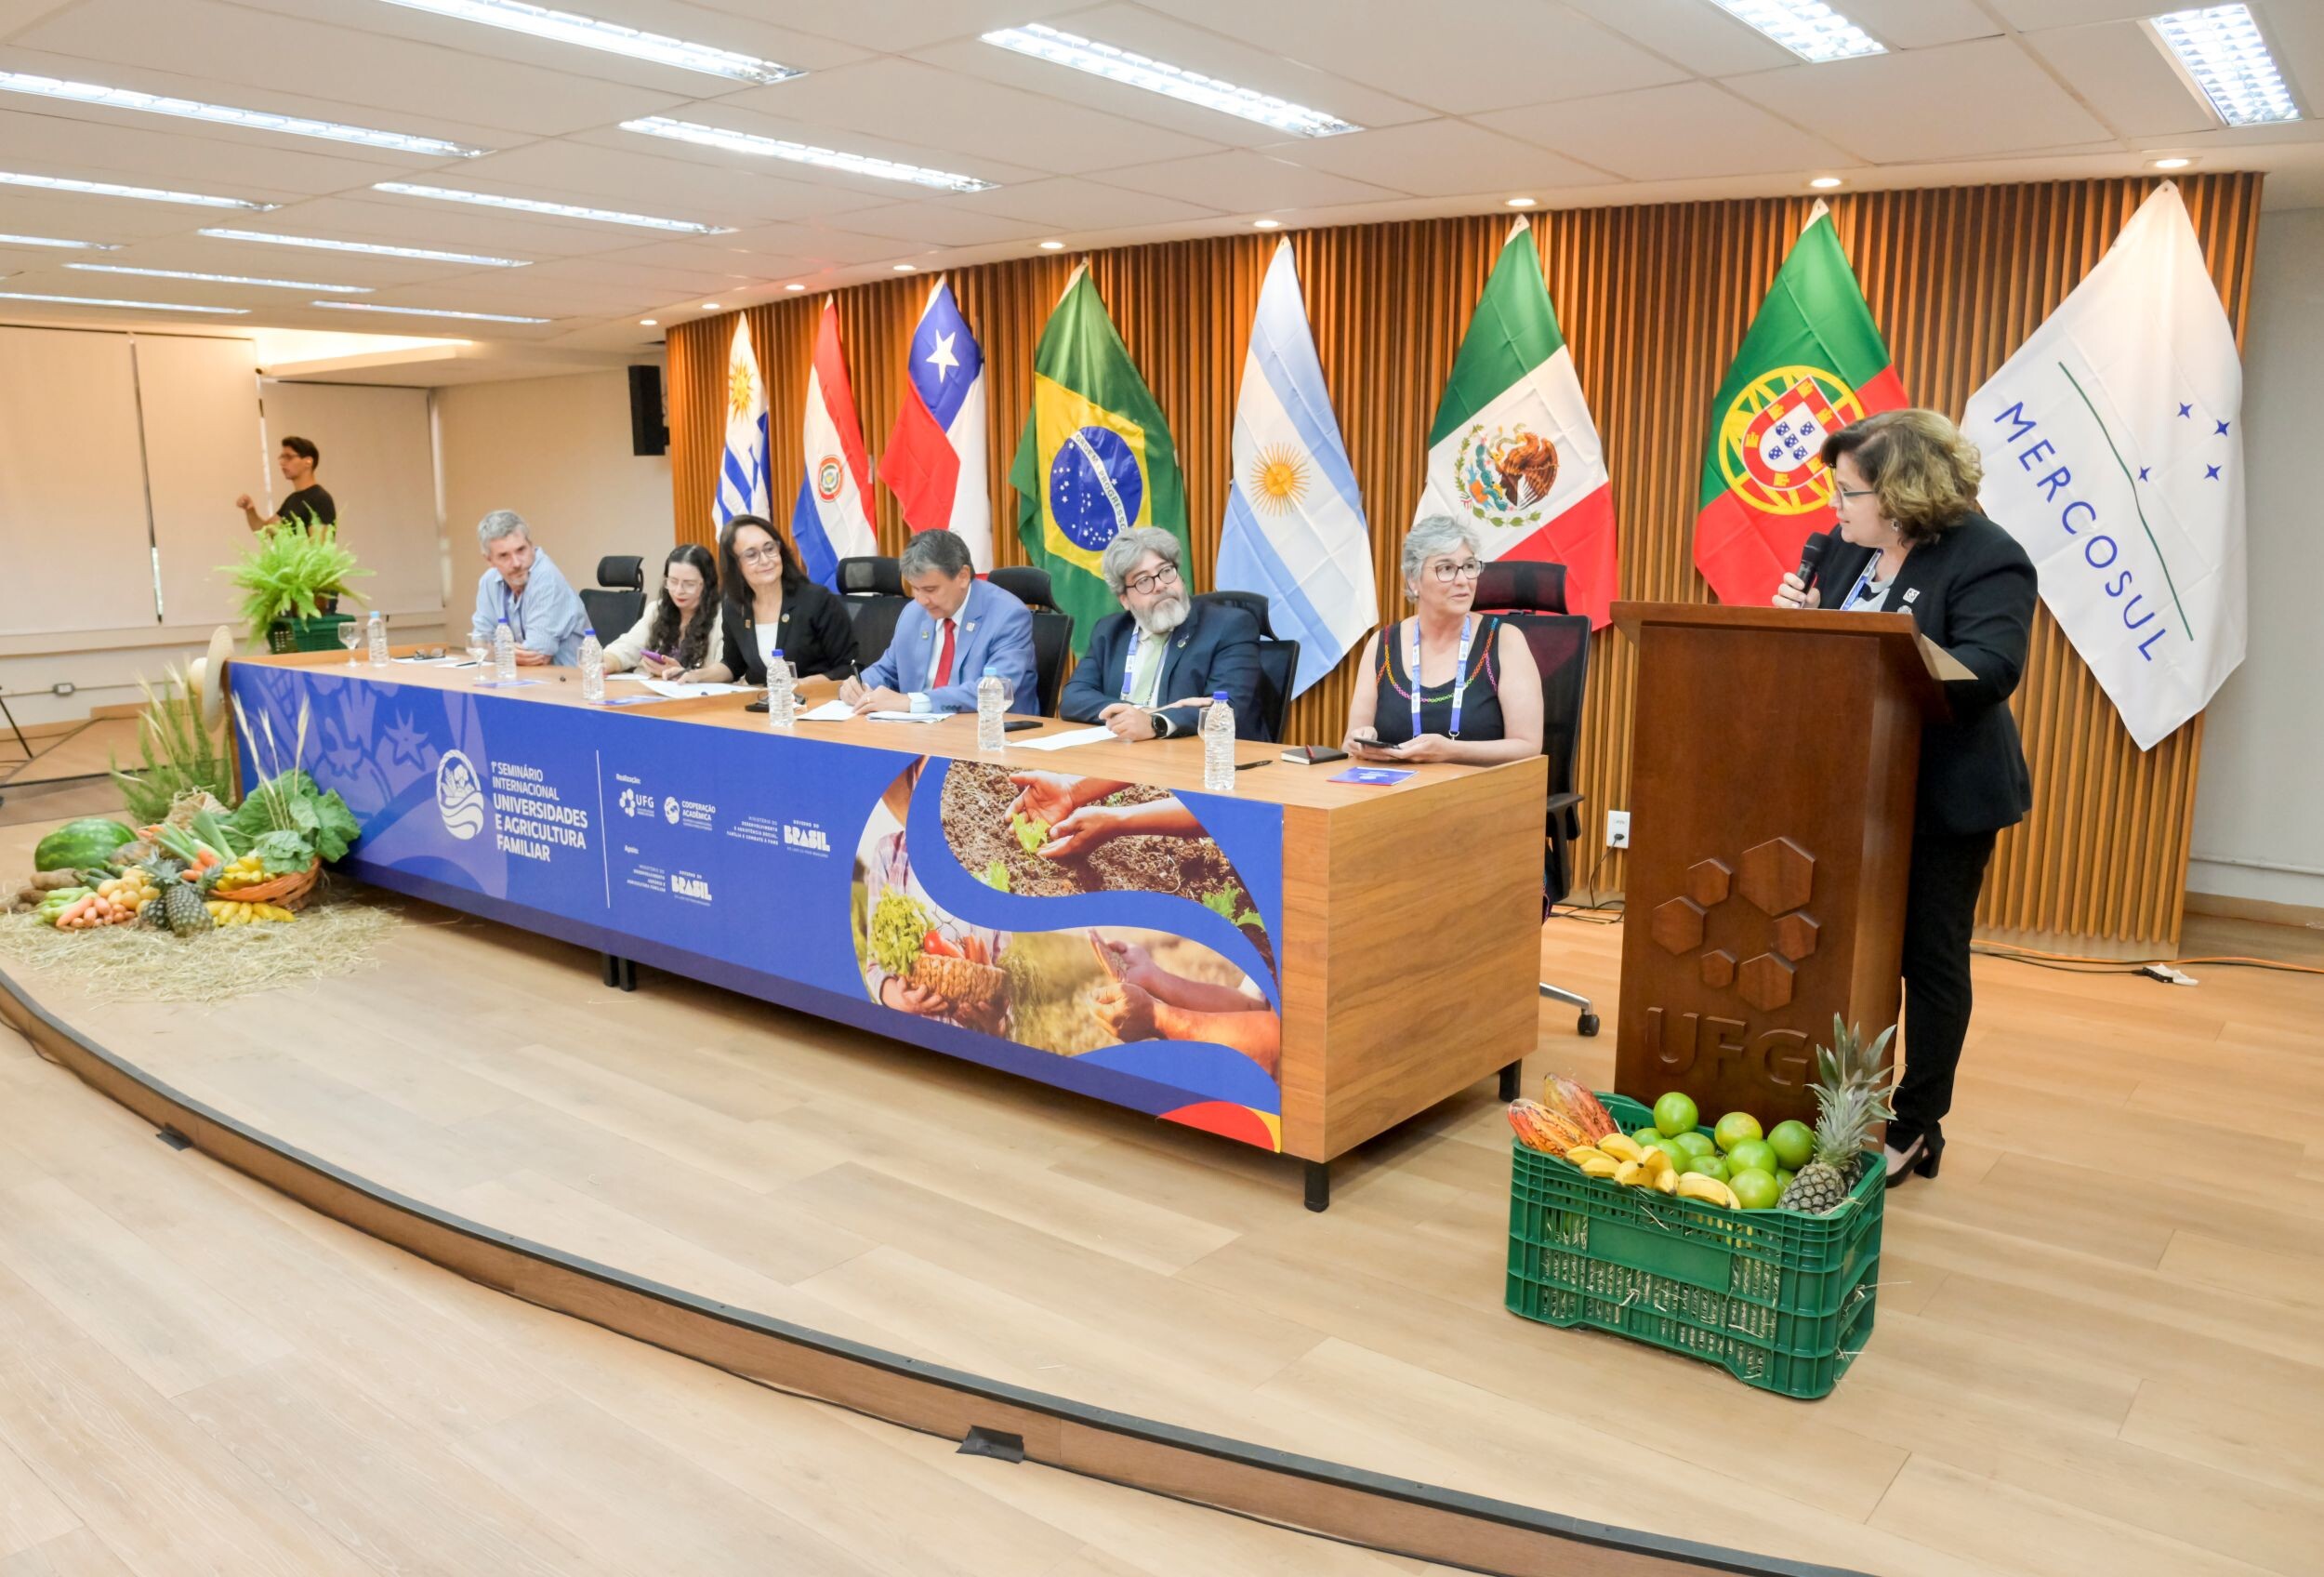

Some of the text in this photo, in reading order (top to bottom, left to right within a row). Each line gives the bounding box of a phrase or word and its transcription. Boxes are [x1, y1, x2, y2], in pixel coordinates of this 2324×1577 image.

[1099, 470, 1127, 532] PROGRESSO
[1994, 401, 2166, 661] MERCOSUL
[497, 762, 544, 782] SEMINÁRIO
[492, 775, 560, 801] INTERNACIONAL
[635, 794, 654, 808] UFG
[493, 792, 588, 828] UNIVERSIDADES
[681, 801, 717, 814] COOPERAÇÃO
[682, 809, 712, 821] ACADÊMICA
[495, 813, 587, 850] E AGRICULTURA
[784, 824, 831, 853] BRASIL
[496, 833, 551, 862] FAMILIAR
[671, 874, 713, 901] BRASIL
[1645, 1007, 1809, 1092] UFG
